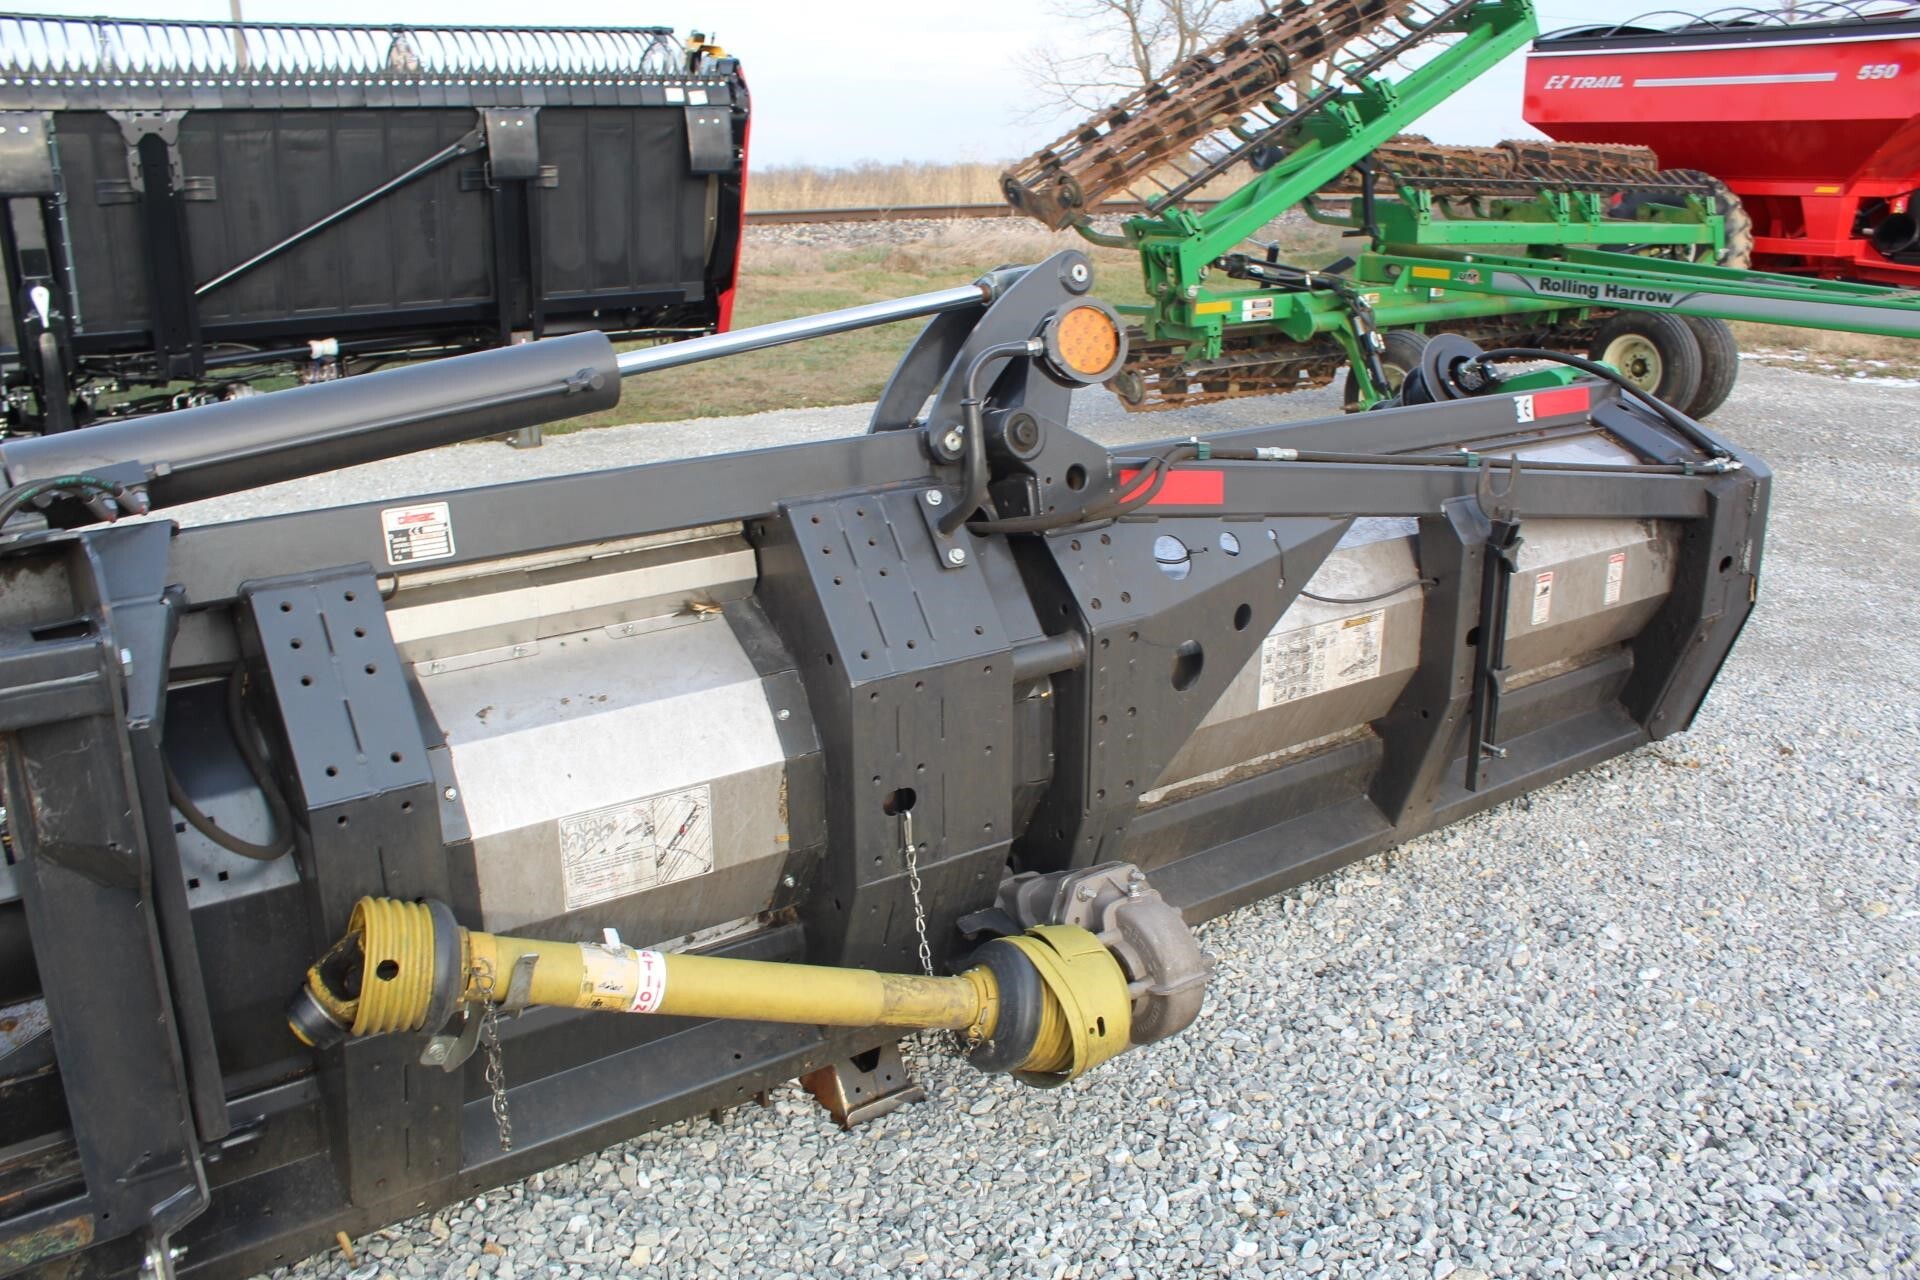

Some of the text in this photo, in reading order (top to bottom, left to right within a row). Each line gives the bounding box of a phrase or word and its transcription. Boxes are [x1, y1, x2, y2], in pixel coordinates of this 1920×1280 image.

[1856, 64, 1900, 80] 550
[1570, 75, 1624, 89] TRAIL
[1540, 277, 1673, 303] Rolling Harrow
